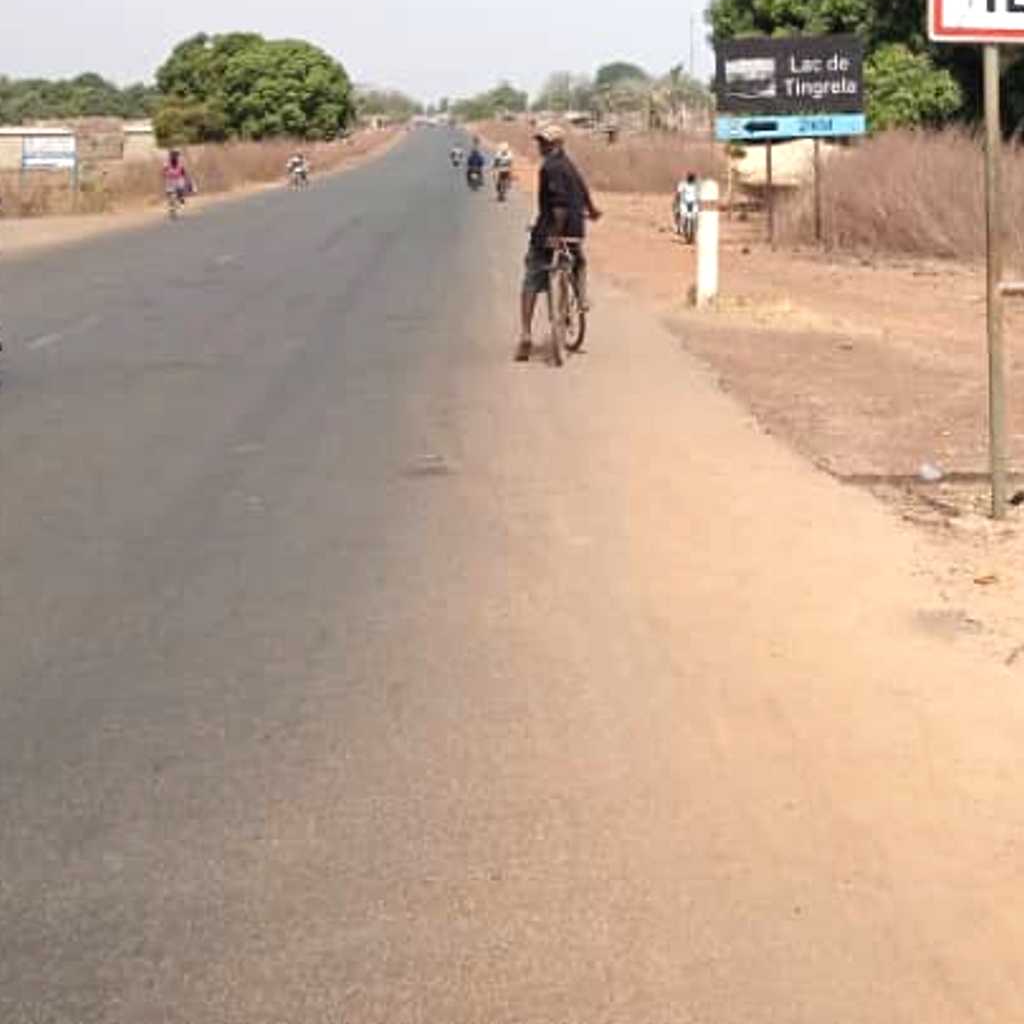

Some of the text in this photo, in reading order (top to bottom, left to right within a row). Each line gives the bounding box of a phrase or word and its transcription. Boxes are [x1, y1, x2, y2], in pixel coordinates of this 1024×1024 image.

[790, 52, 849, 74] Lac de
[785, 77, 856, 98] Tingrela
